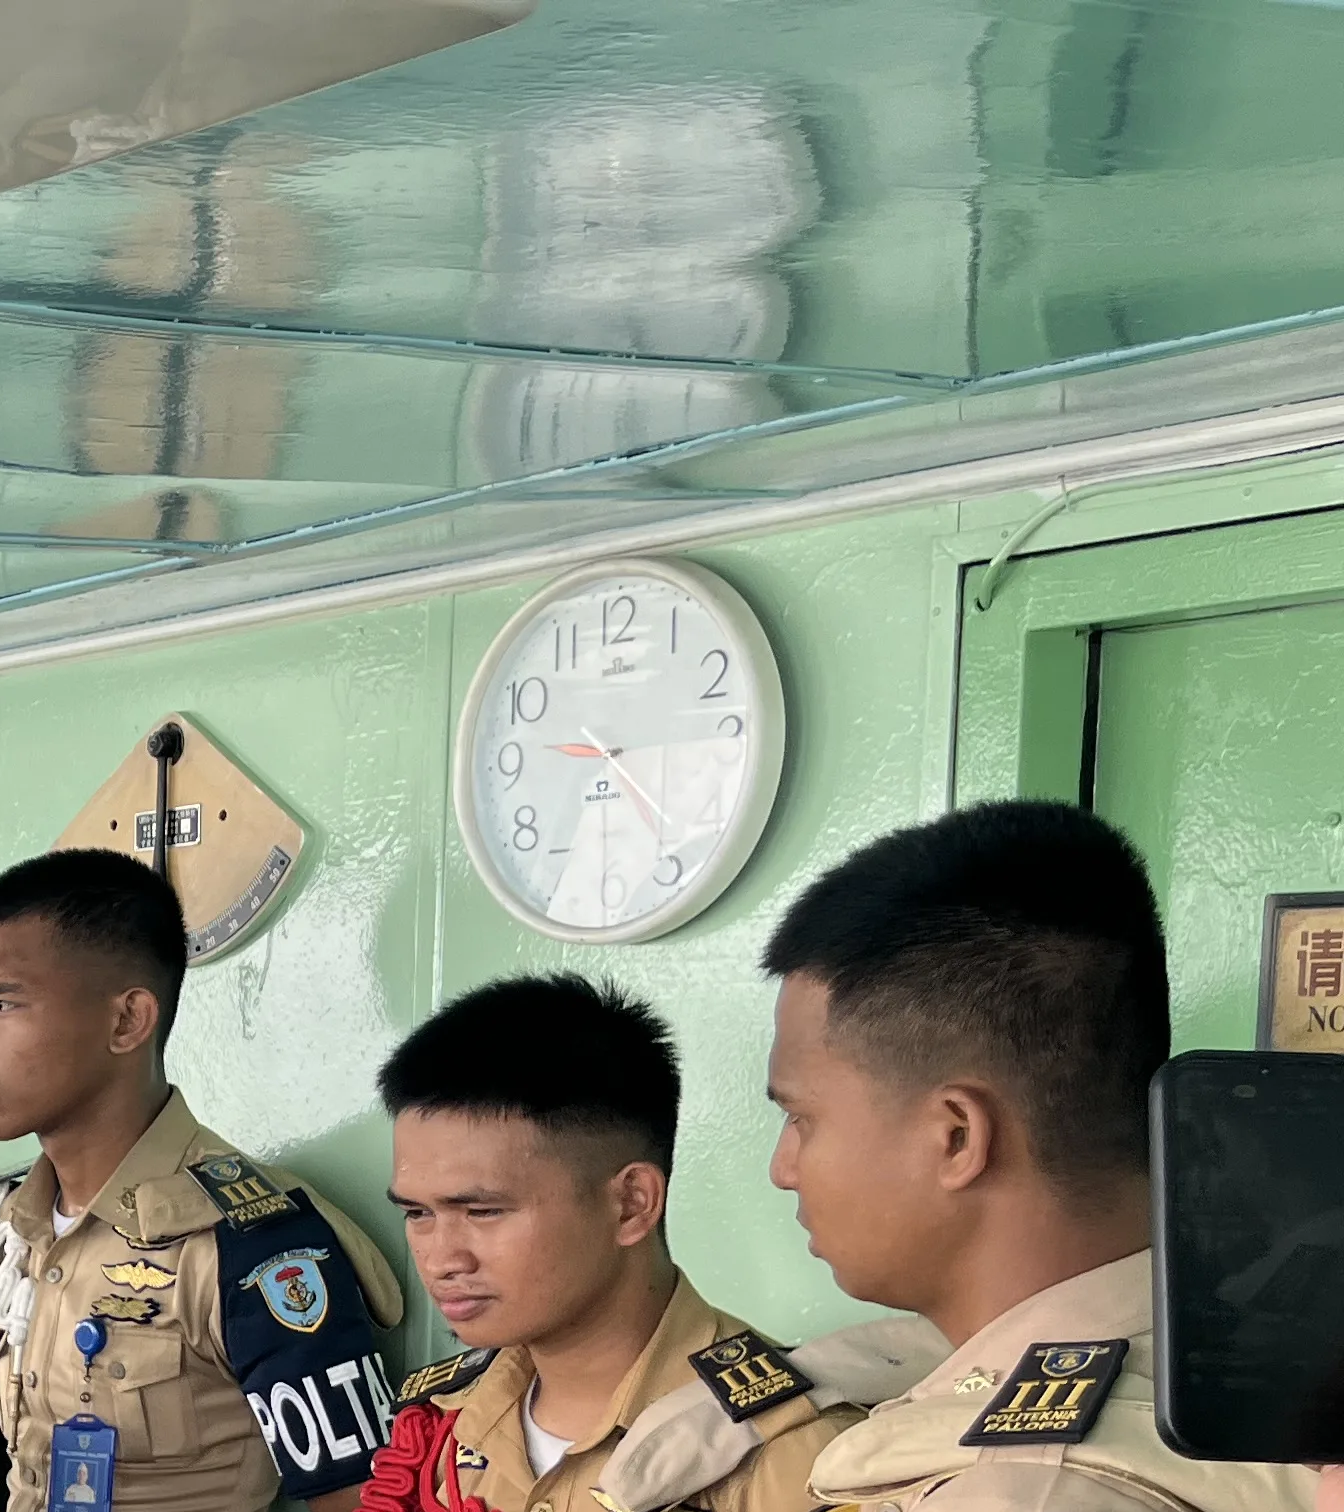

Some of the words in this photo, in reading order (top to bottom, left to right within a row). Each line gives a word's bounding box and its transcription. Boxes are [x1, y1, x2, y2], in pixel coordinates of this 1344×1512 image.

[602, 596, 636, 646] 12
[670, 606, 677, 654] 1
[555, 623, 577, 672] 11
[699, 649, 729, 700] 2
[510, 676, 548, 726] 10
[498, 741, 524, 791] 9
[512, 805, 539, 852] 8
[269, 867, 280, 884] 50
[250, 896, 261, 910] 40
[206, 935, 216, 949] 20
[228, 919, 239, 933] 30
[218, 1176, 272, 1206] III
[716, 1352, 783, 1395] III
[737, 1379, 795, 1408] PALOPO
[998, 1377, 1097, 1413] III
[246, 1352, 395, 1477] POLTA
[983, 1409, 1081, 1424] POLITEKNIK
[983, 1421, 1069, 1434] PALOPO
